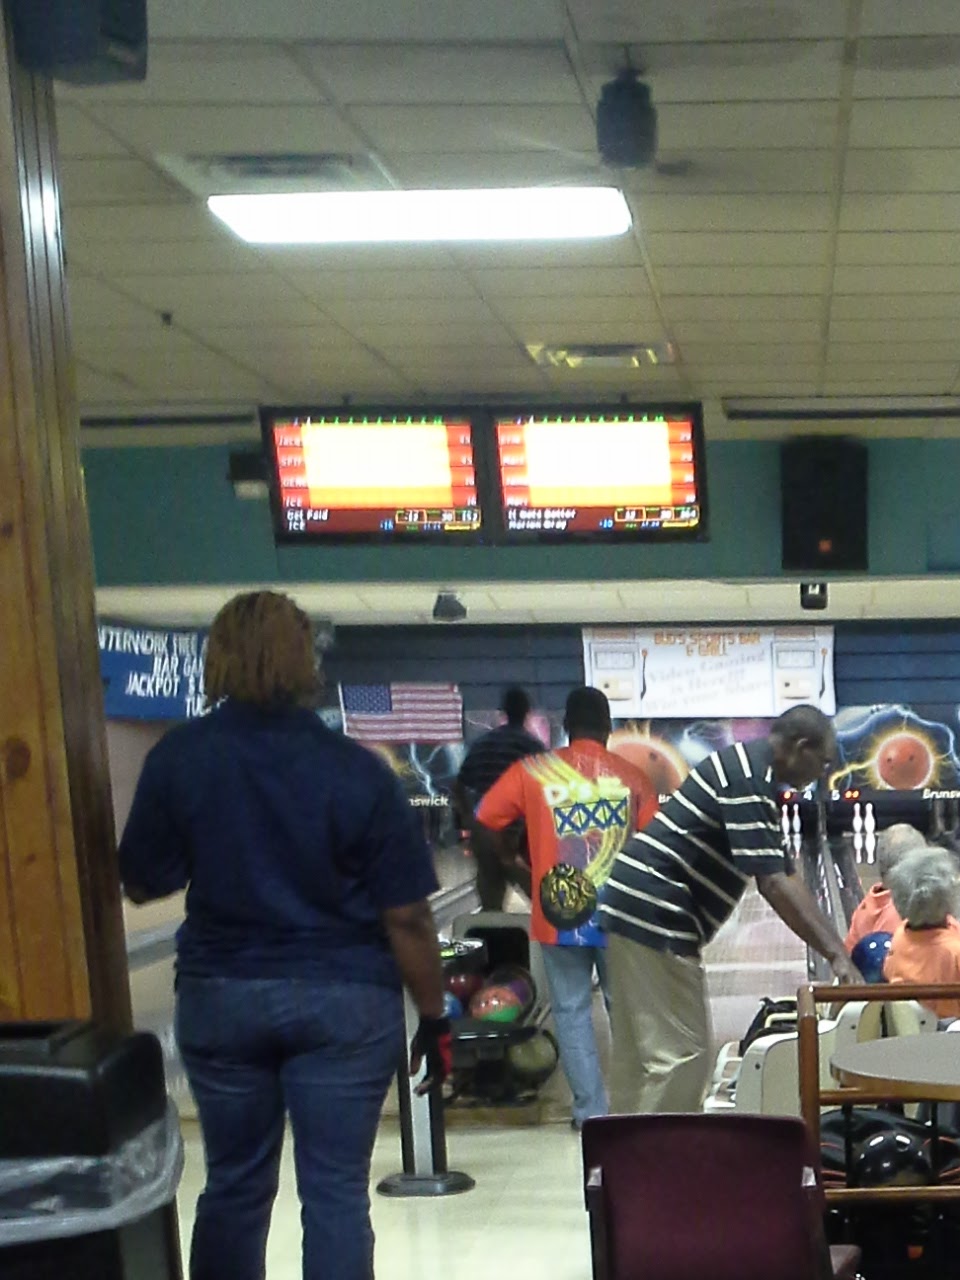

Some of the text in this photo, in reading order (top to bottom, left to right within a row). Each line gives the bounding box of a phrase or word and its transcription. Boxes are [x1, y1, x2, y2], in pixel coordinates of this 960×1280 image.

[125, 671, 181, 698] JACKPOT
[803, 790, 813, 800] 4
[832, 790, 841, 800] 5
[553, 796, 630, 837] XXX
